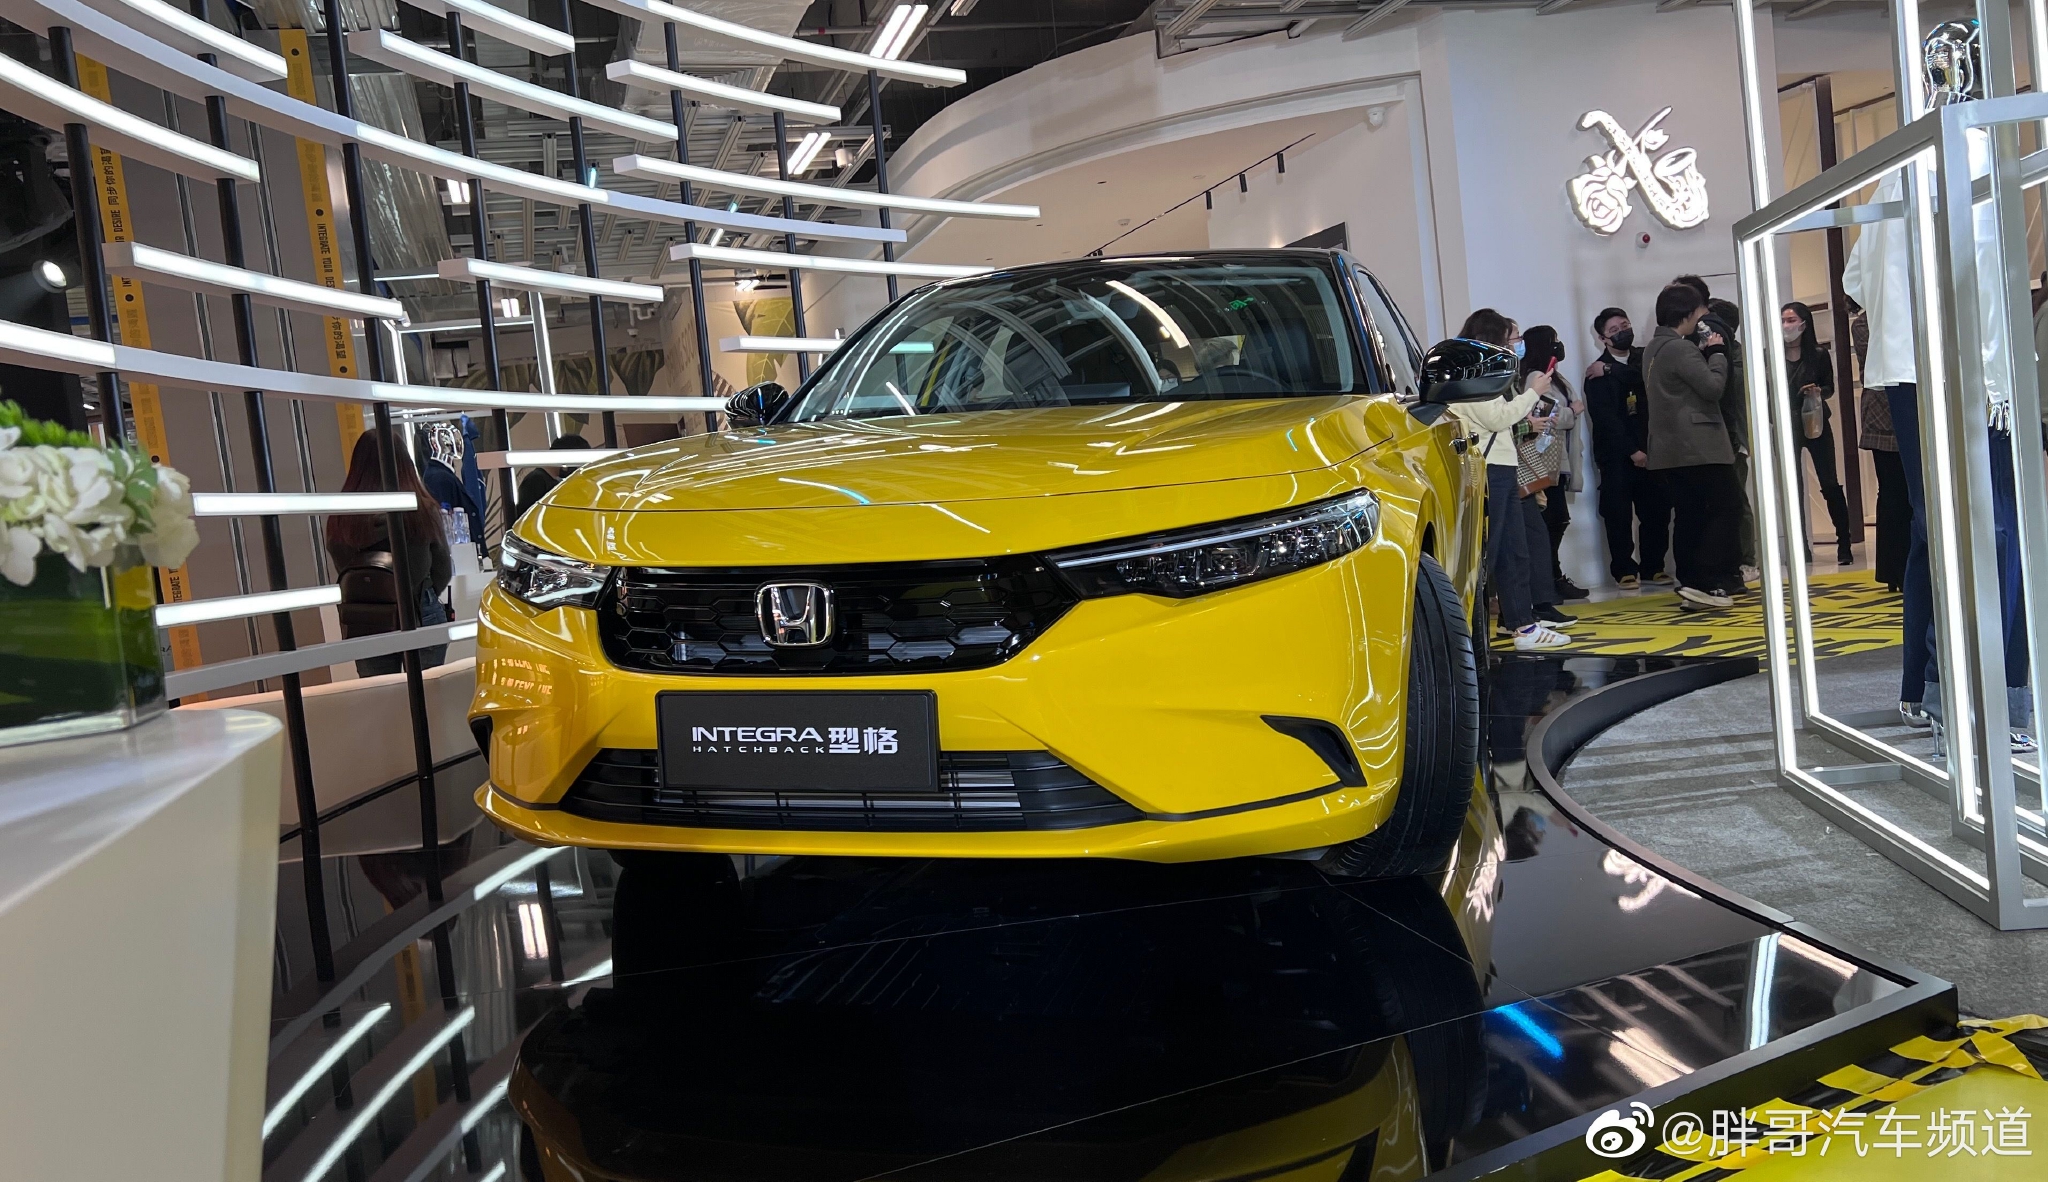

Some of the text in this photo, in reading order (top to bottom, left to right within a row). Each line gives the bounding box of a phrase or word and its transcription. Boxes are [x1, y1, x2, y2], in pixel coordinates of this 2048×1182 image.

[111, 210, 123, 232] DESIRE
[317, 223, 330, 255] INTEGRATE
[322, 257, 333, 273] YOUR
[325, 276, 335, 288] DES
[170, 576, 182, 602] TEGRATE
[692, 726, 898, 755] INTEGRA 型格
[692, 746, 825, 754] HATCHBACK
